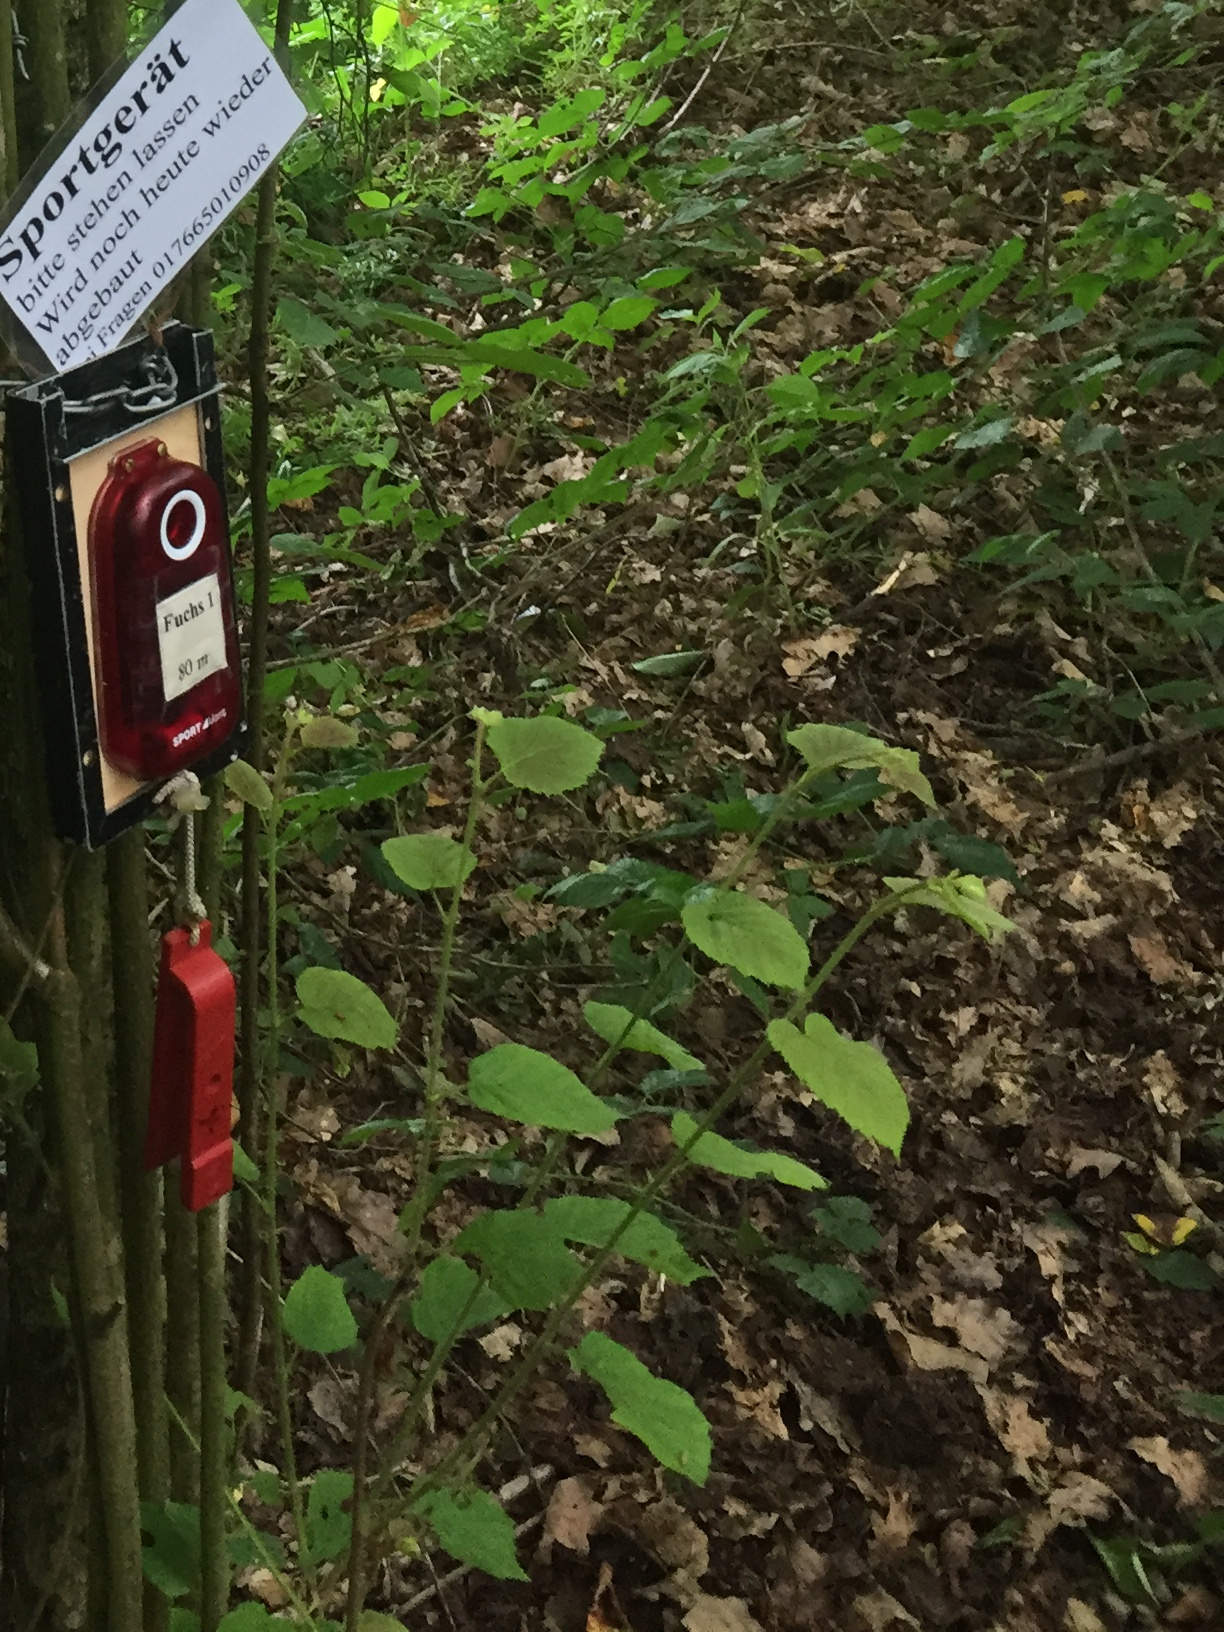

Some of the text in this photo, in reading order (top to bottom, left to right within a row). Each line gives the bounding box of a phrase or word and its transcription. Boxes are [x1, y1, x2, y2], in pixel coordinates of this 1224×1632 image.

[17, 92, 201, 314] bitte stehen lassen
[36, 57, 274, 335] Wird noch heute wieder
[97, 142, 271, 349] Fragen 017665010908
[56, 249, 144, 366] abgebaut
[163, 601, 205, 633] Fuchs
[178, 653, 209, 682] 80 m
